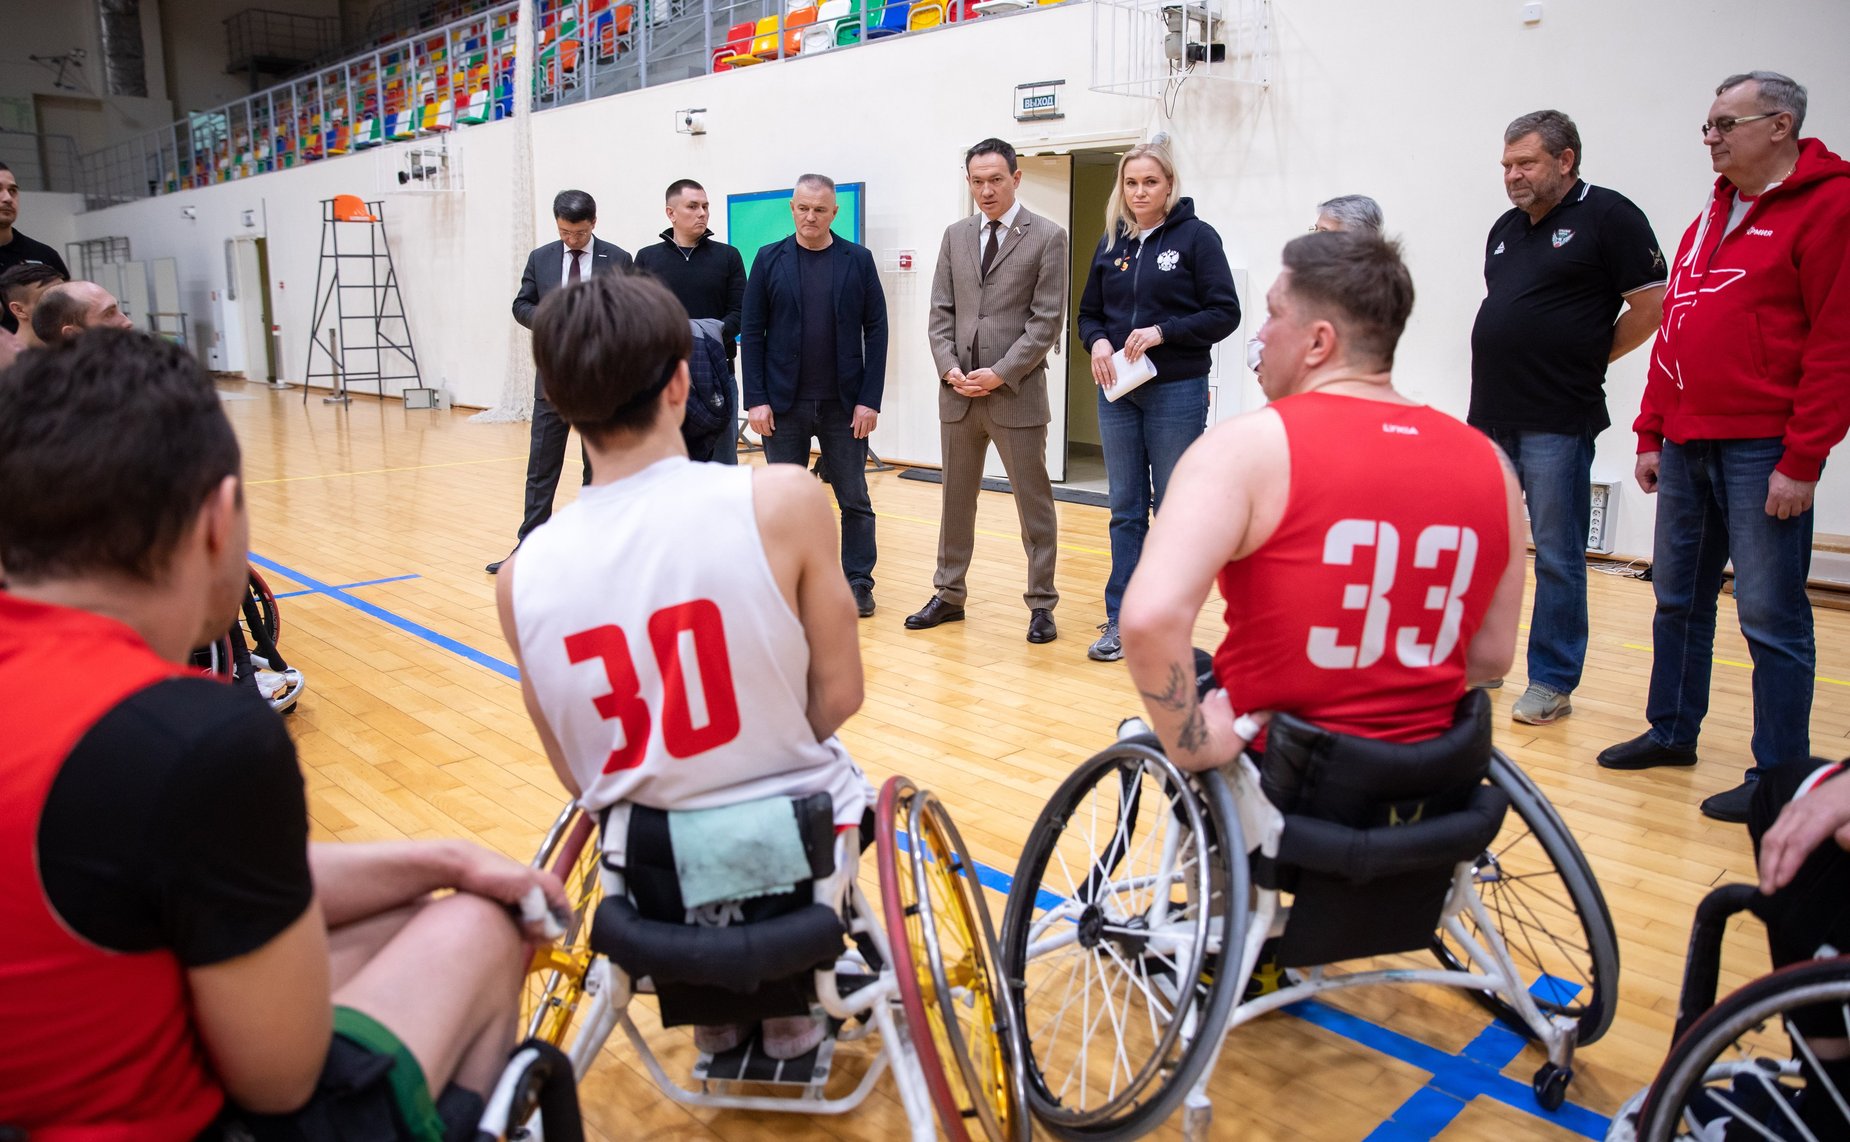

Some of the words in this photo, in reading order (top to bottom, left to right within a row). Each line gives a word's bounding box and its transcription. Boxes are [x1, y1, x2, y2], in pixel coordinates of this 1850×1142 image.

[1024, 96, 1054, 108] ВЫХОД
[1306, 518, 1479, 670] 33
[563, 597, 742, 776] 30
